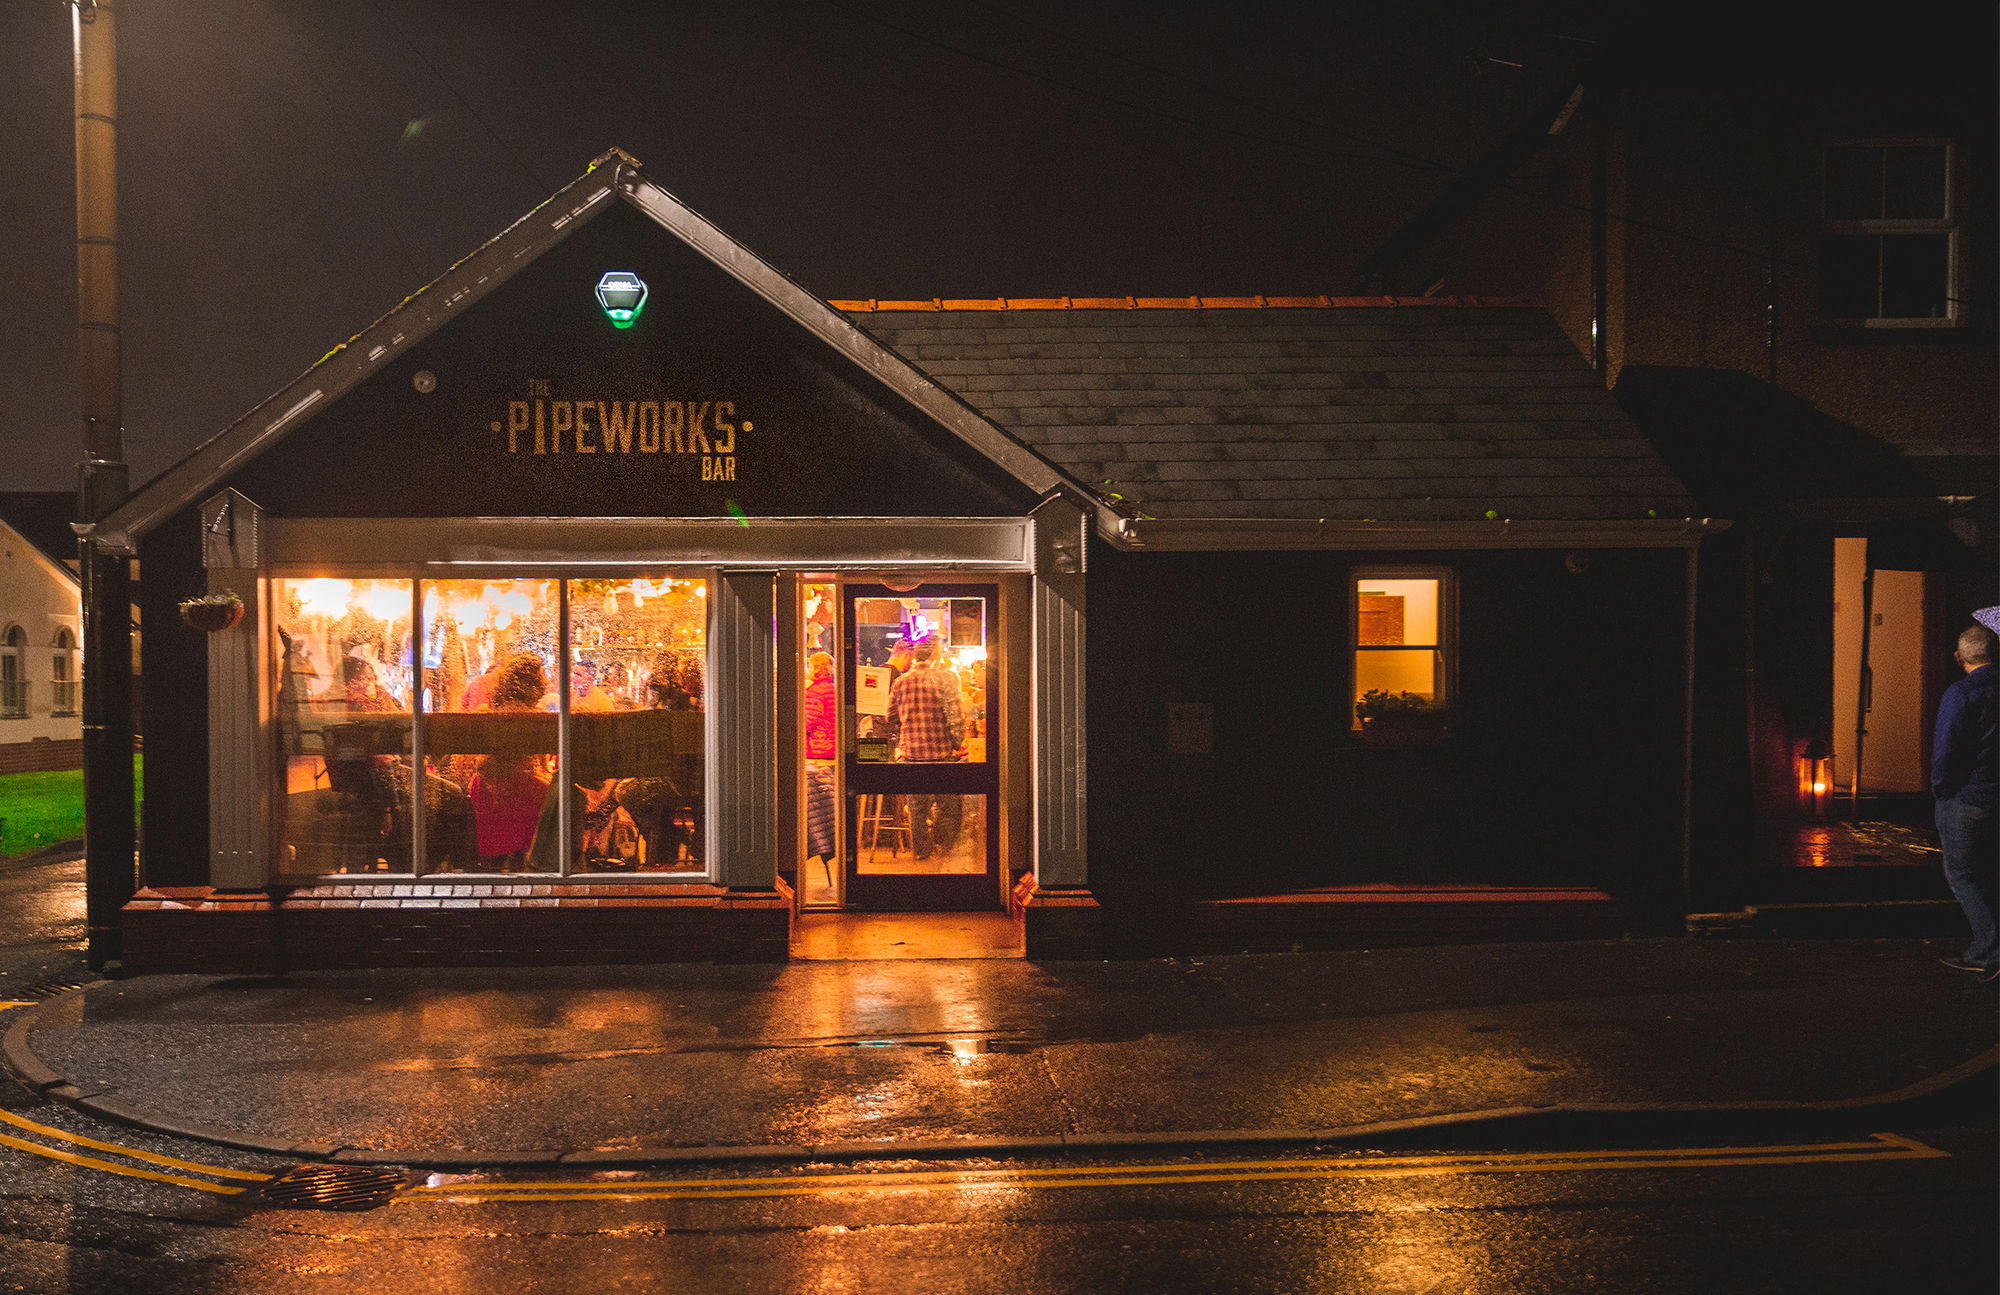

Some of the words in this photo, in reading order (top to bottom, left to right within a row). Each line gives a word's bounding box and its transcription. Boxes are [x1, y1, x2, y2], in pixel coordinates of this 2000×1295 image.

[528, 378, 551, 396] THE
[507, 398, 736, 454] PIPEWORKS
[701, 456, 736, 481] BAR
